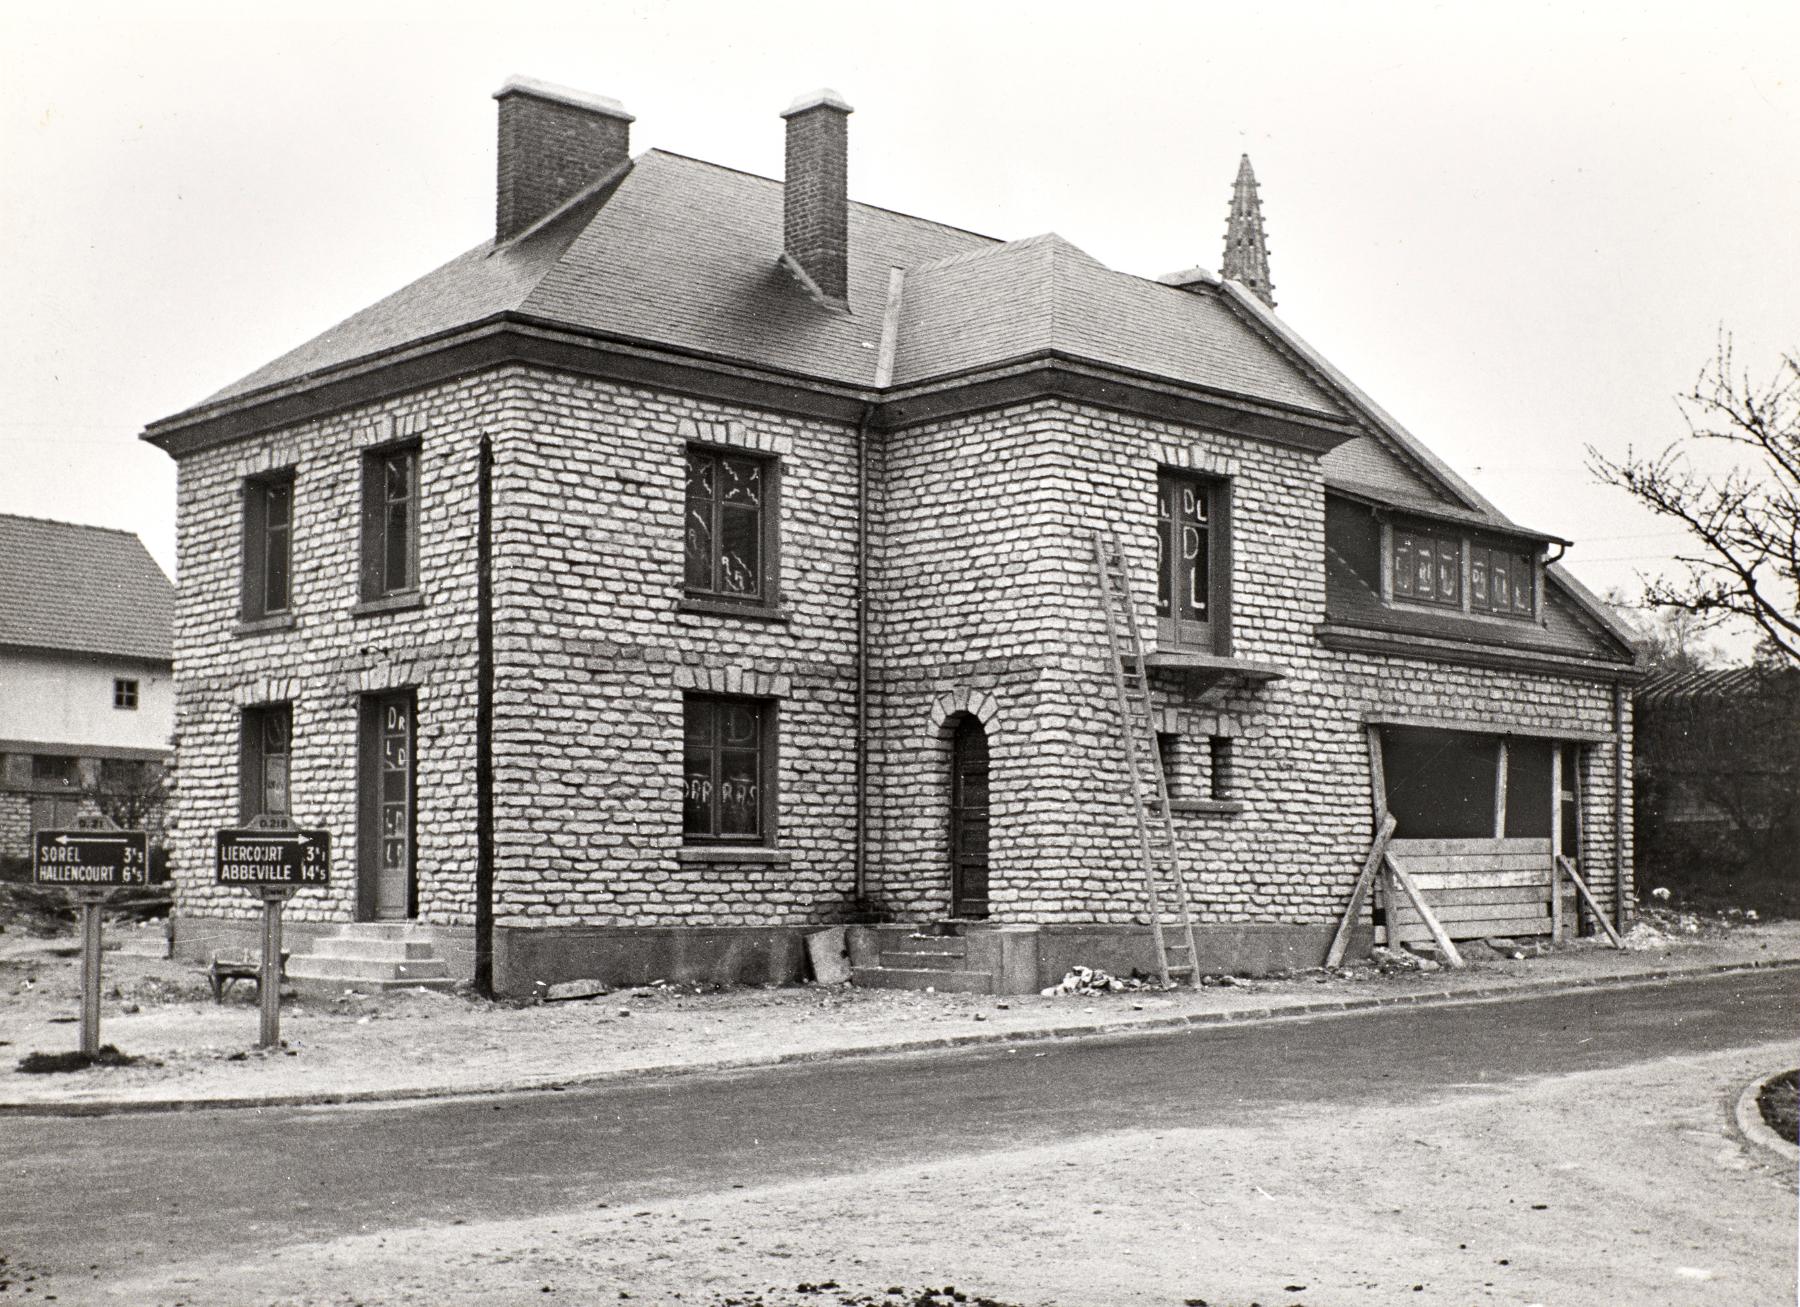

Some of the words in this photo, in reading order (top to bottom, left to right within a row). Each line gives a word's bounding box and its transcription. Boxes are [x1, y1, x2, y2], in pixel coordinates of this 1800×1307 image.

[41, 846, 81, 862] SOREL
[221, 845, 284, 862] LIERCOURT
[39, 865, 115, 881] HALLENCOURT
[221, 864, 292, 881] ABBEVILLE
